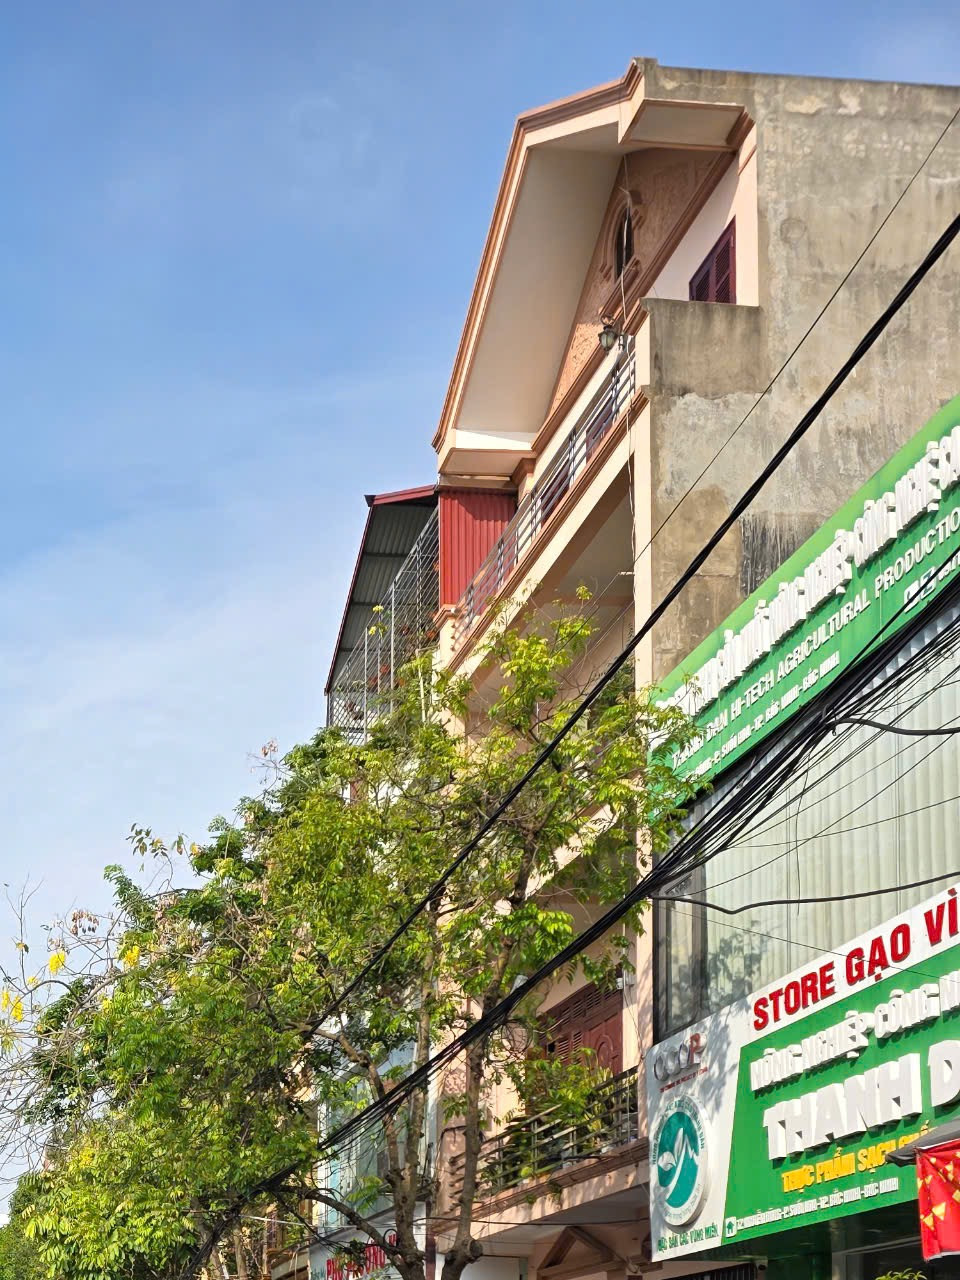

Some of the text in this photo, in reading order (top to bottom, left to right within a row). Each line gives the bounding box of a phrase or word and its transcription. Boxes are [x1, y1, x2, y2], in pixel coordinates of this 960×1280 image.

[730, 669, 775, 722] HI-TECH
[777, 588, 871, 683] AGRICULTURAL
[753, 961, 837, 1031] STORE
[845, 923, 912, 983] GẠO
[750, 1044, 804, 1092] NÔNG
[801, 1010, 874, 1072] NGHIỆP
[873, 983, 940, 1040] CÔNG
[763, 1052, 923, 1162] THANH
[782, 1164, 814, 1193] THỰC
[815, 1147, 855, 1184] PHẨM
